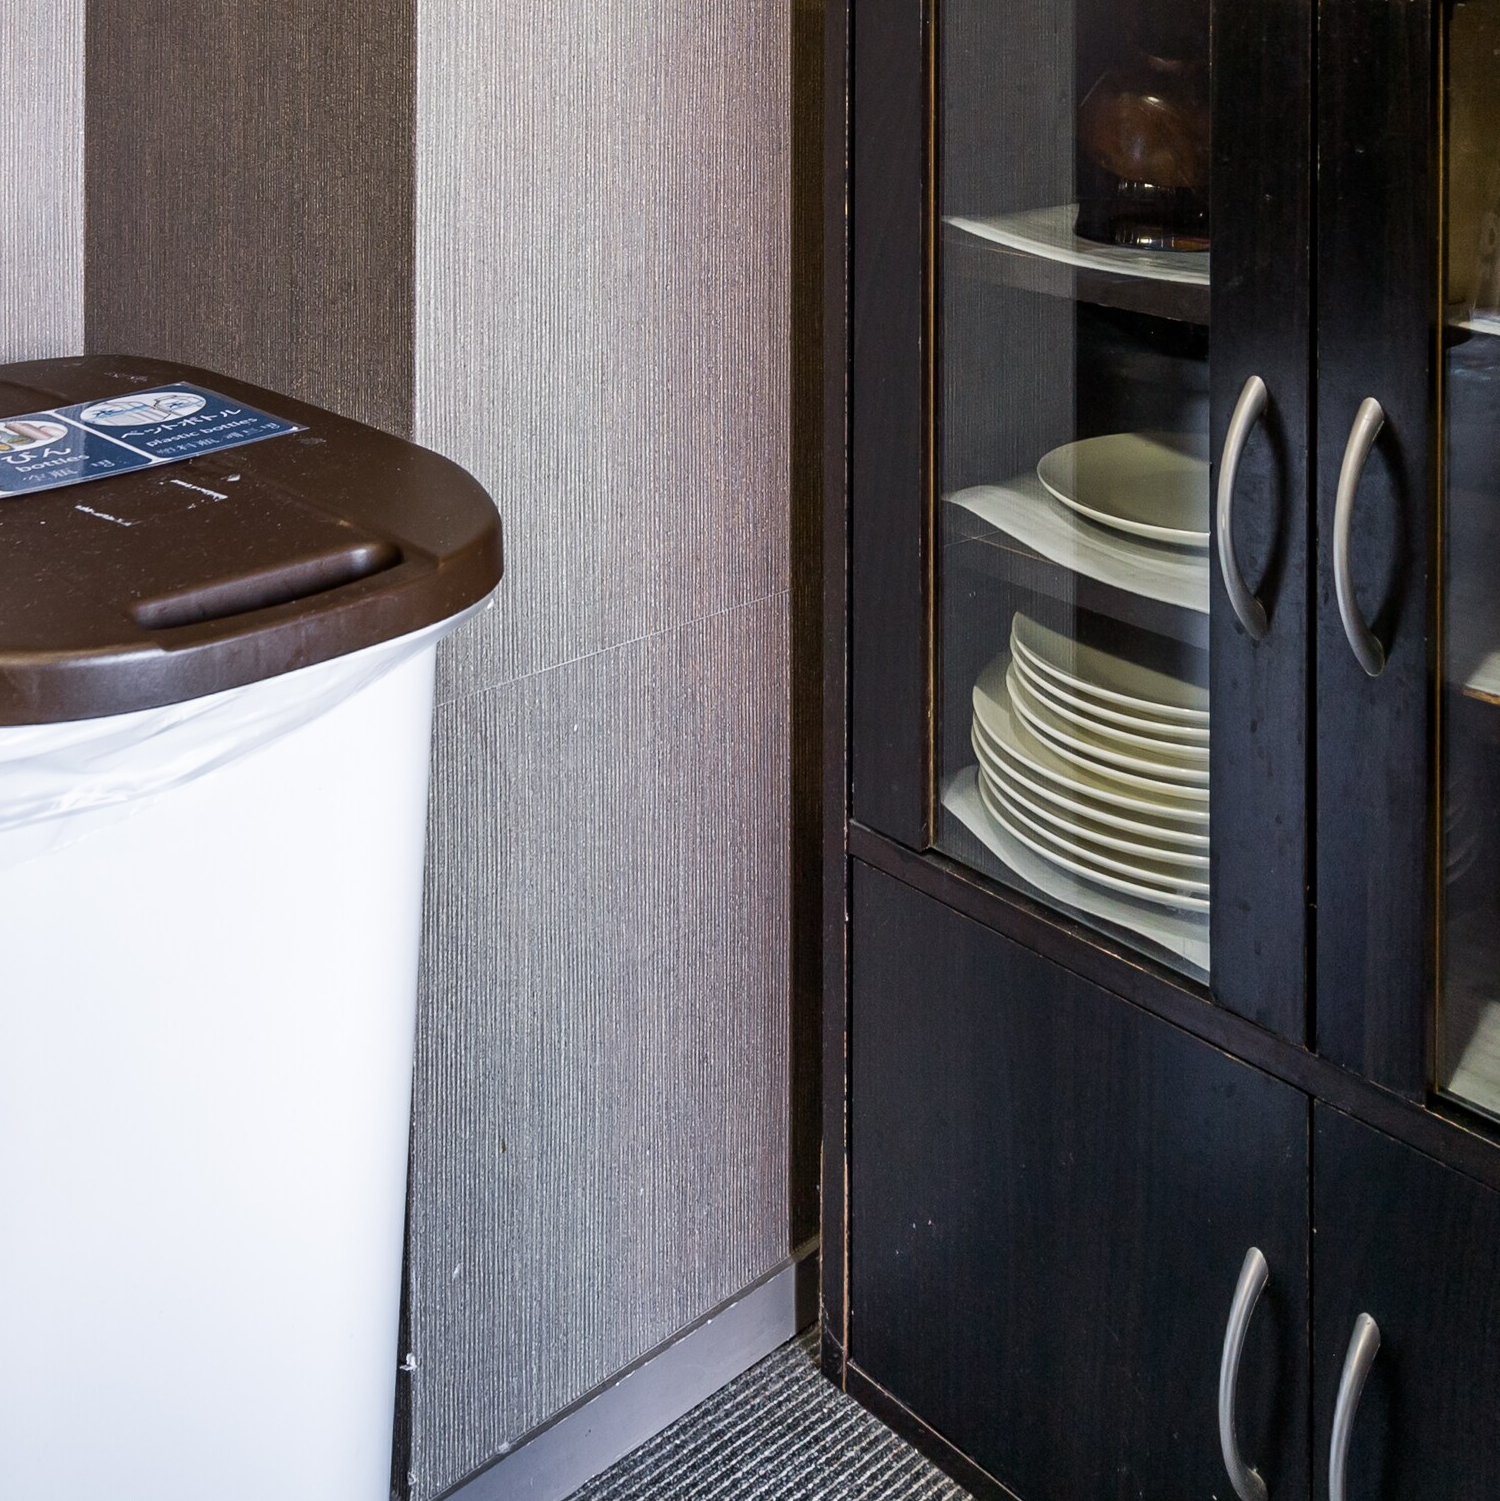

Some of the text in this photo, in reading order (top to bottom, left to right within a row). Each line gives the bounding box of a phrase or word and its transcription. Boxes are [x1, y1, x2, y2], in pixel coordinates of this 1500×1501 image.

[121, 408, 242, 439] ペットボトル
[145, 416, 258, 448] plastic bottles
[0, 447, 71, 465] びん
[15, 454, 90, 473] bottles
